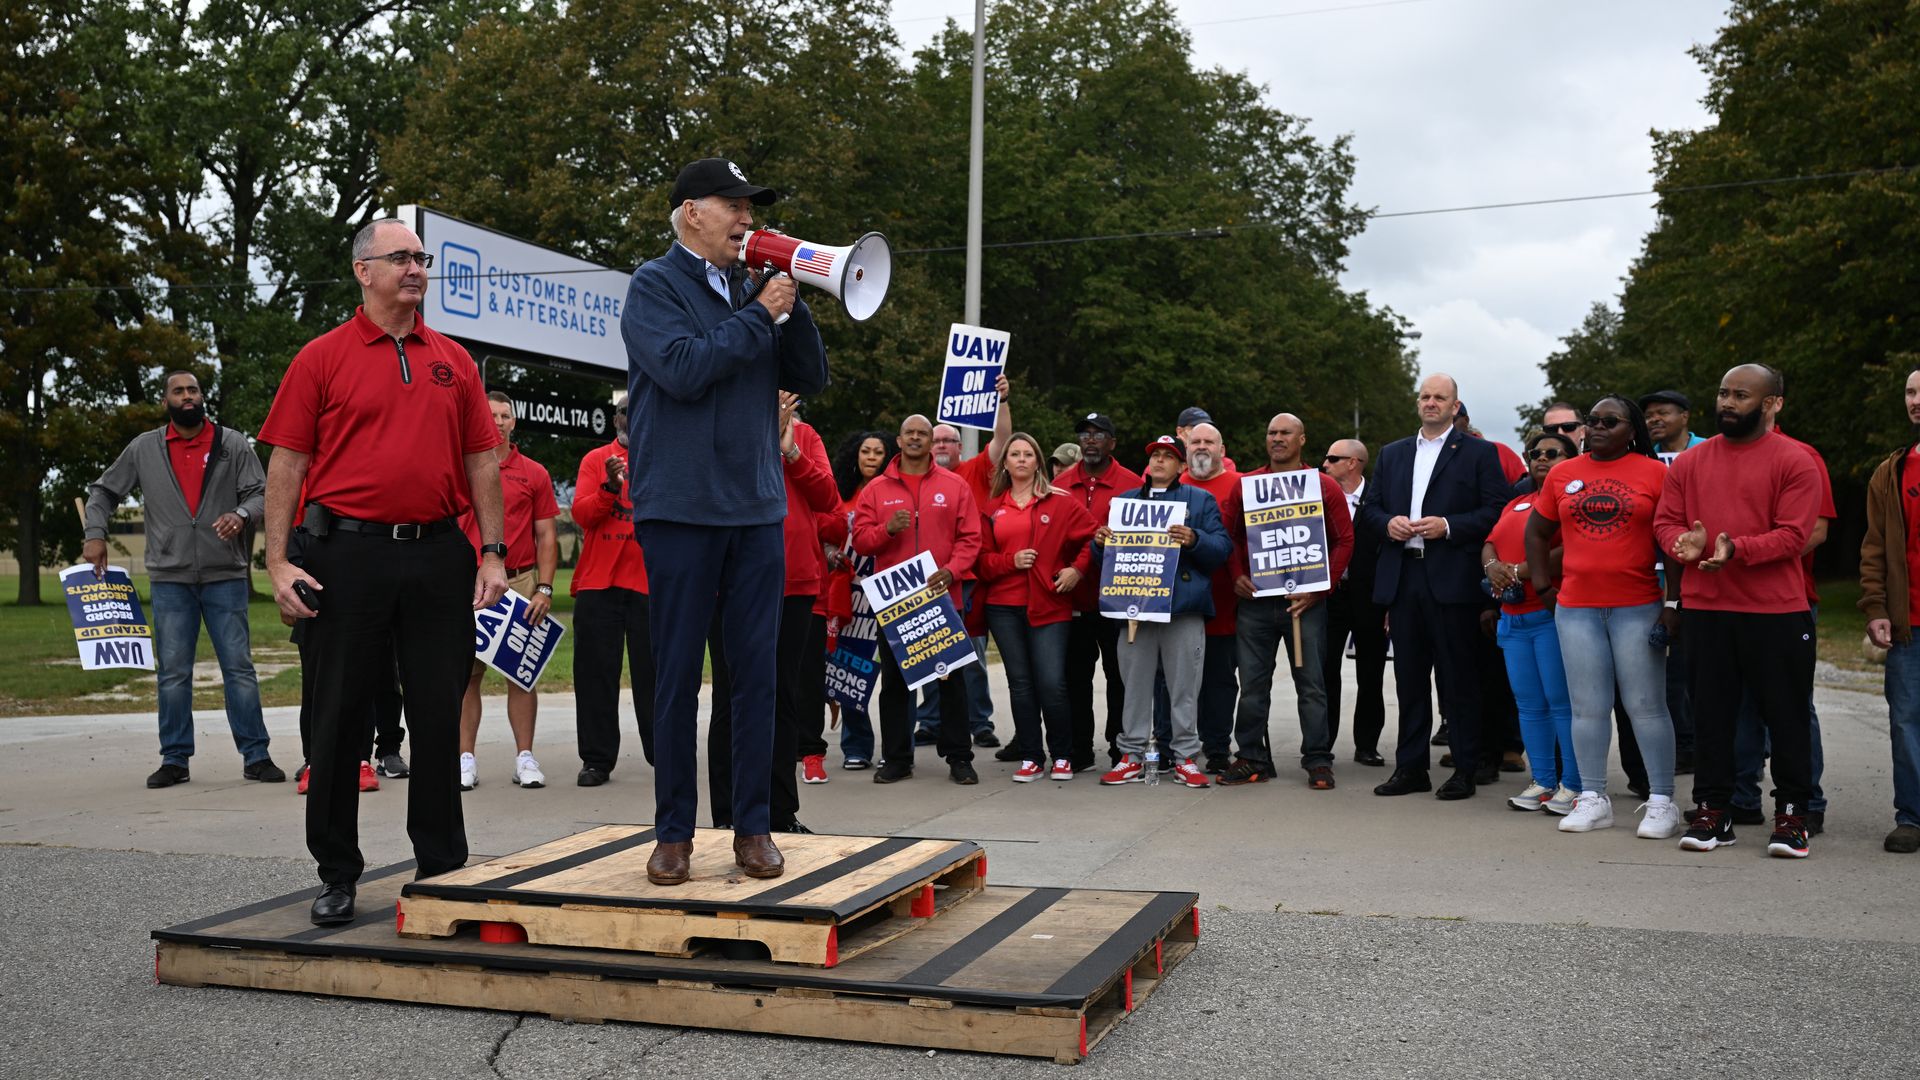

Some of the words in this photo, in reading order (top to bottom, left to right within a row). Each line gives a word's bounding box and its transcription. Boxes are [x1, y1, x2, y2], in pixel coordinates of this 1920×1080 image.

[448, 261, 474, 300] gm
[488, 266, 577, 307] CUSTOMER
[583, 291, 621, 318] CARE
[488, 291, 499, 313] &
[505, 296, 607, 337] AFTERSALES
[952, 333, 1005, 363] UAW
[962, 370, 986, 393] ON
[529, 402, 569, 426] LOCAL
[570, 408, 589, 428] 174
[942, 391, 997, 418] STRIKE
[1254, 474, 1307, 504] UAW
[1121, 502, 1174, 528] UAW
[1249, 508, 1295, 524] STAND
[1299, 505, 1318, 515] UP
[1586, 501, 1616, 513] UAW
[1109, 534, 1153, 545] STAND
[1260, 525, 1311, 549] END
[1114, 563, 1164, 574] PROFITS
[1115, 552, 1166, 564] RECORD
[1252, 544, 1323, 570] TIERS
[66, 582, 134, 595] CONTRACTS
[874, 559, 926, 601] UAW
[1101, 586, 1171, 597] CONTRACTS
[1113, 575, 1162, 586] RECORD
[81, 592, 129, 603] RECORD
[83, 602, 132, 614] PROFITS
[882, 595, 923, 623] STAND
[86, 610, 134, 622] RECORD
[896, 605, 943, 635] RECORD
[81, 628, 100, 637] UP
[104, 626, 147, 635] STAND
[507, 621, 530, 654] ON
[901, 615, 947, 644] PROFITS
[906, 627, 952, 655] RECORD
[95, 641, 145, 666] UAW
[516, 621, 552, 684] STRIKE
[901, 631, 967, 670] CONTRACTS
